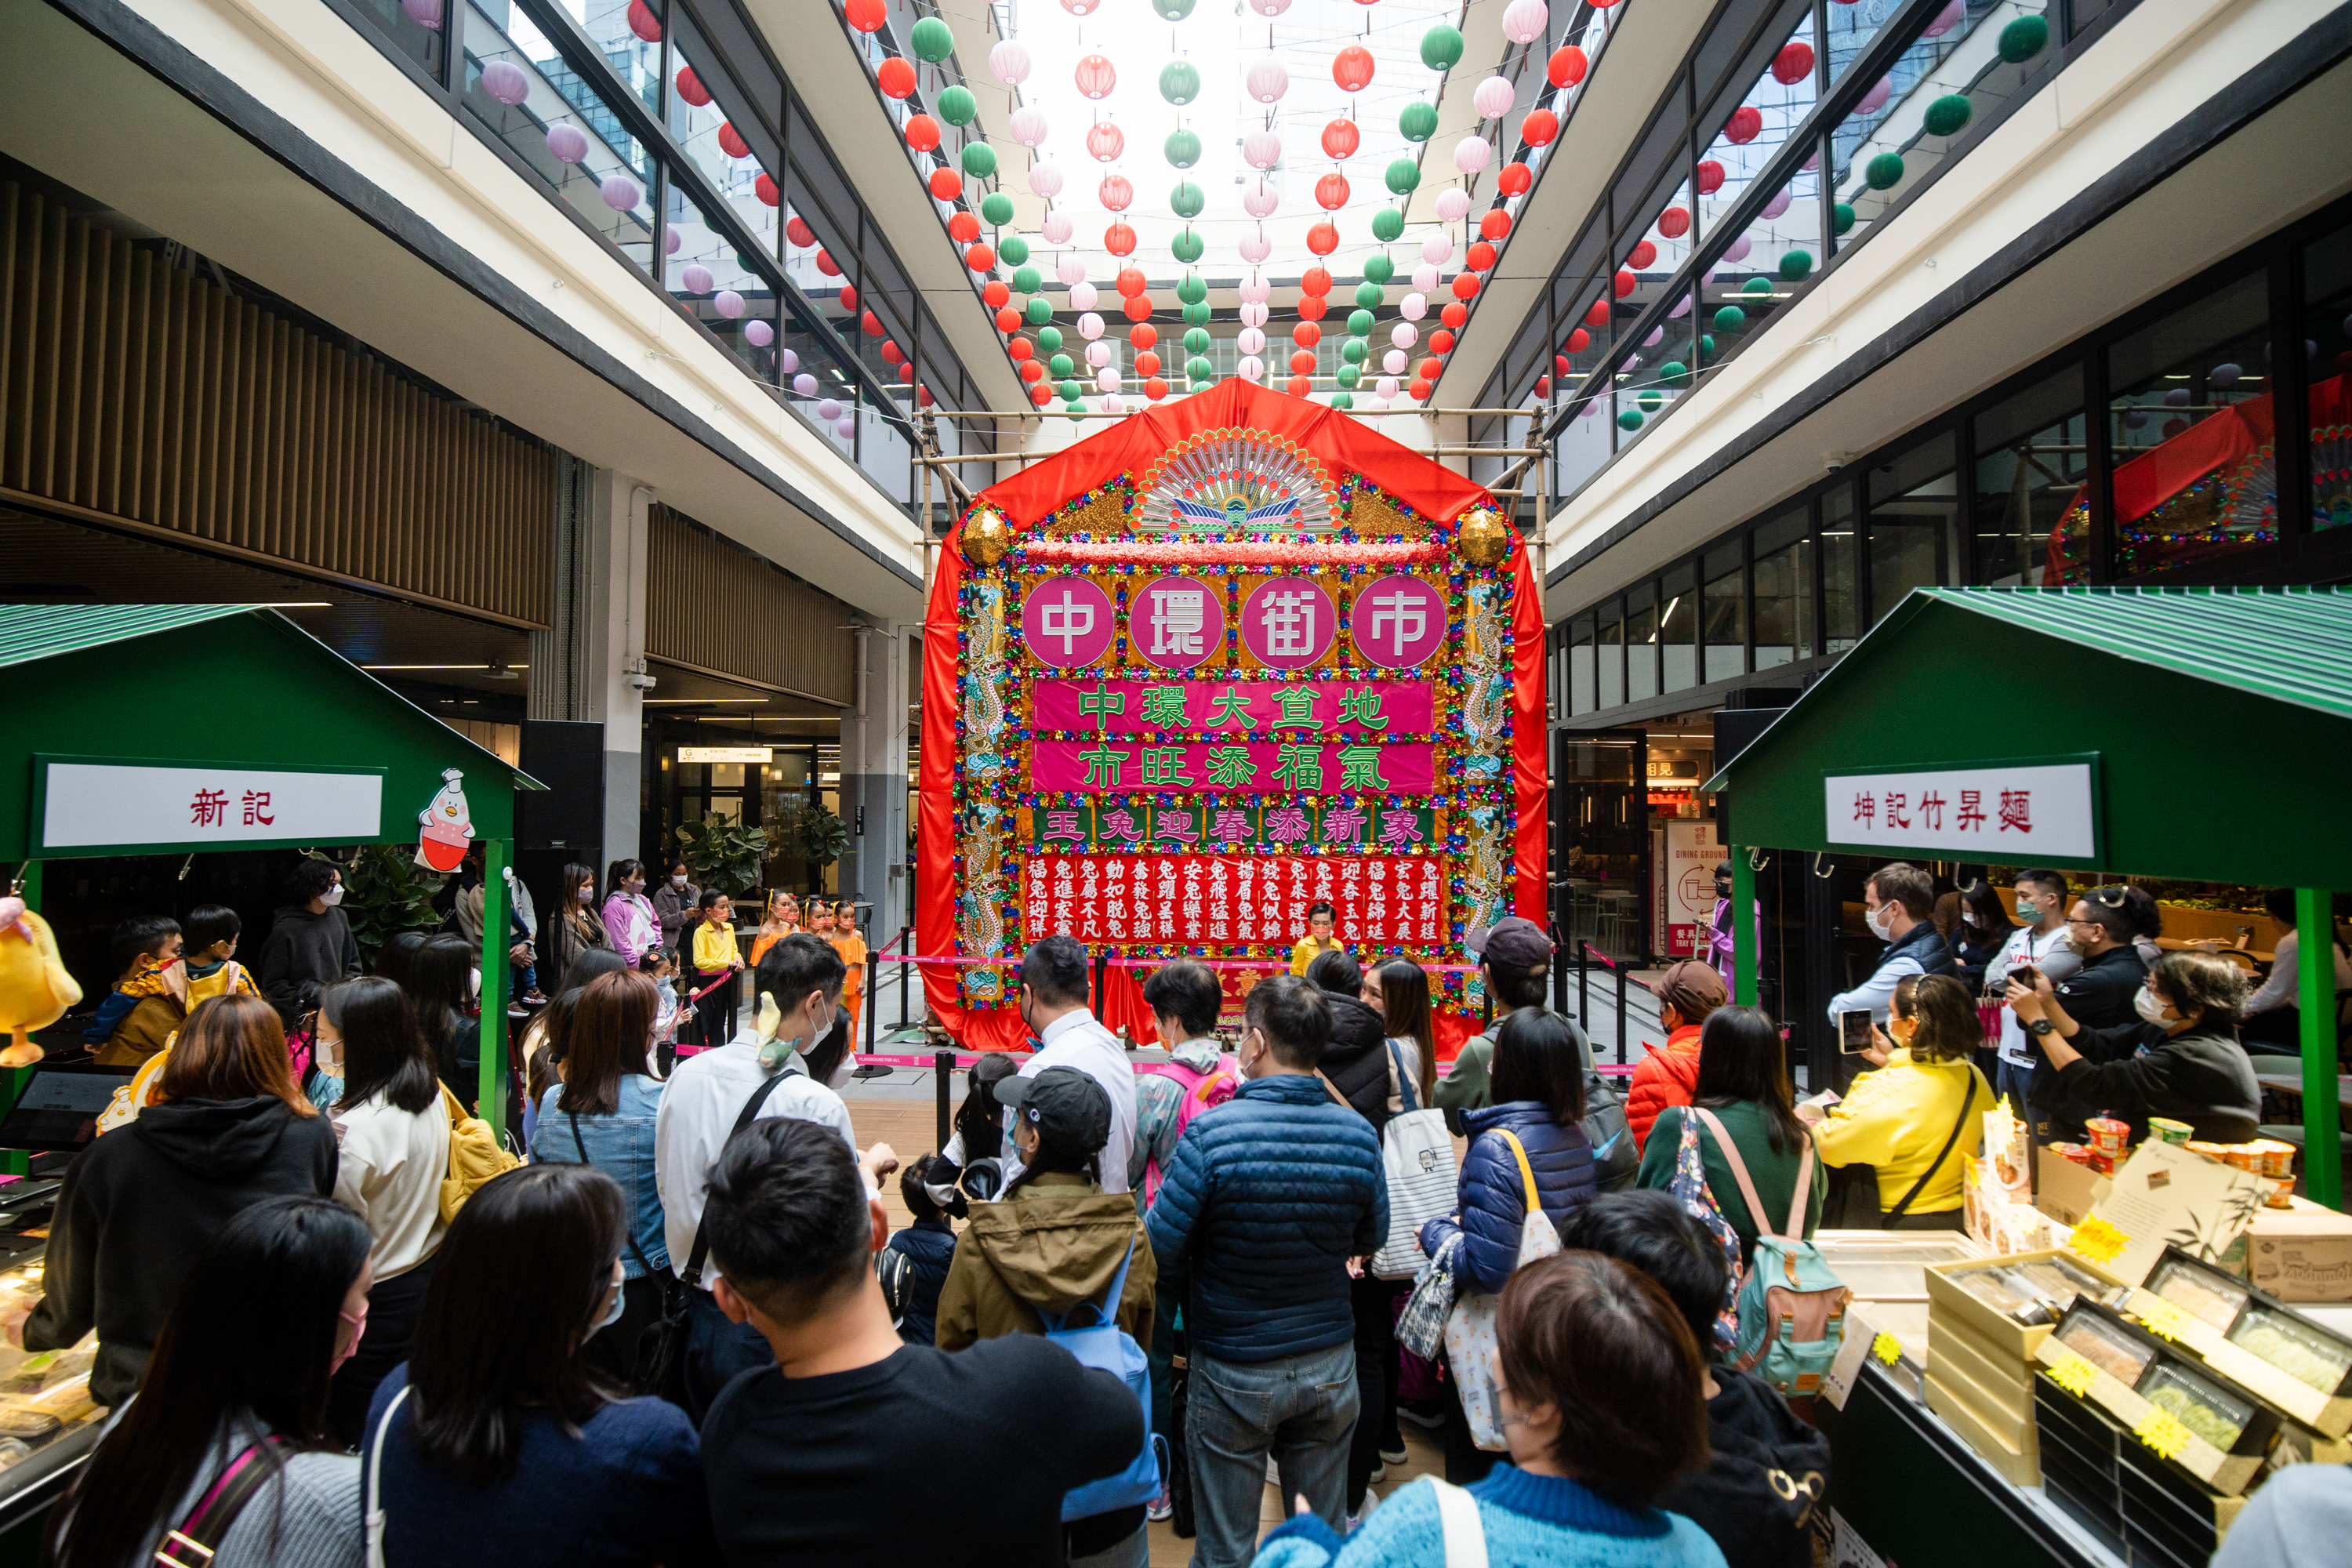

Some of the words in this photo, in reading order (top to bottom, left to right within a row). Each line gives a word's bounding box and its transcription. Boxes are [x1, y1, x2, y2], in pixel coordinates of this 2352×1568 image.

[1041, 590, 1427, 656] 中環街市
[1078, 683, 1390, 731] 中環大笪地
[1078, 743, 1390, 791] 市旺添福氣
[190, 788, 275, 828] 新記
[1043, 808, 1424, 844] 玉兔迎春添新象
[1853, 787, 2034, 833] 坤記竹昇麵
[1676, 850, 1698, 858] DINING
[1700, 850, 1727, 859] GROUND
[1028, 859, 1050, 938] 福兔迎祥
[1054, 859, 1076, 937] 兔進家富
[1079, 859, 1102, 938] 兔屬不凡
[1102, 859, 1127, 938] 動如脫兔
[1131, 859, 1152, 938] 奮發兔強
[1156, 859, 1177, 938] 兔躍呈祥
[1182, 859, 1203, 940] 安兔樂業
[1207, 859, 1230, 940] 兔飛猛進
[1235, 859, 1257, 940] 揚眉兔氣
[1261, 860, 1284, 940] 錢兔似錦
[1288, 860, 1309, 939] 兔來運轉
[1341, 862, 1362, 940] 迎春玉兔
[1366, 861, 1388, 940] 福兔綿延
[1394, 860, 1414, 940] 宏兔大展
[1417, 860, 1439, 940] 兔躍新程
[1676, 928, 1711, 939] 餐具回
